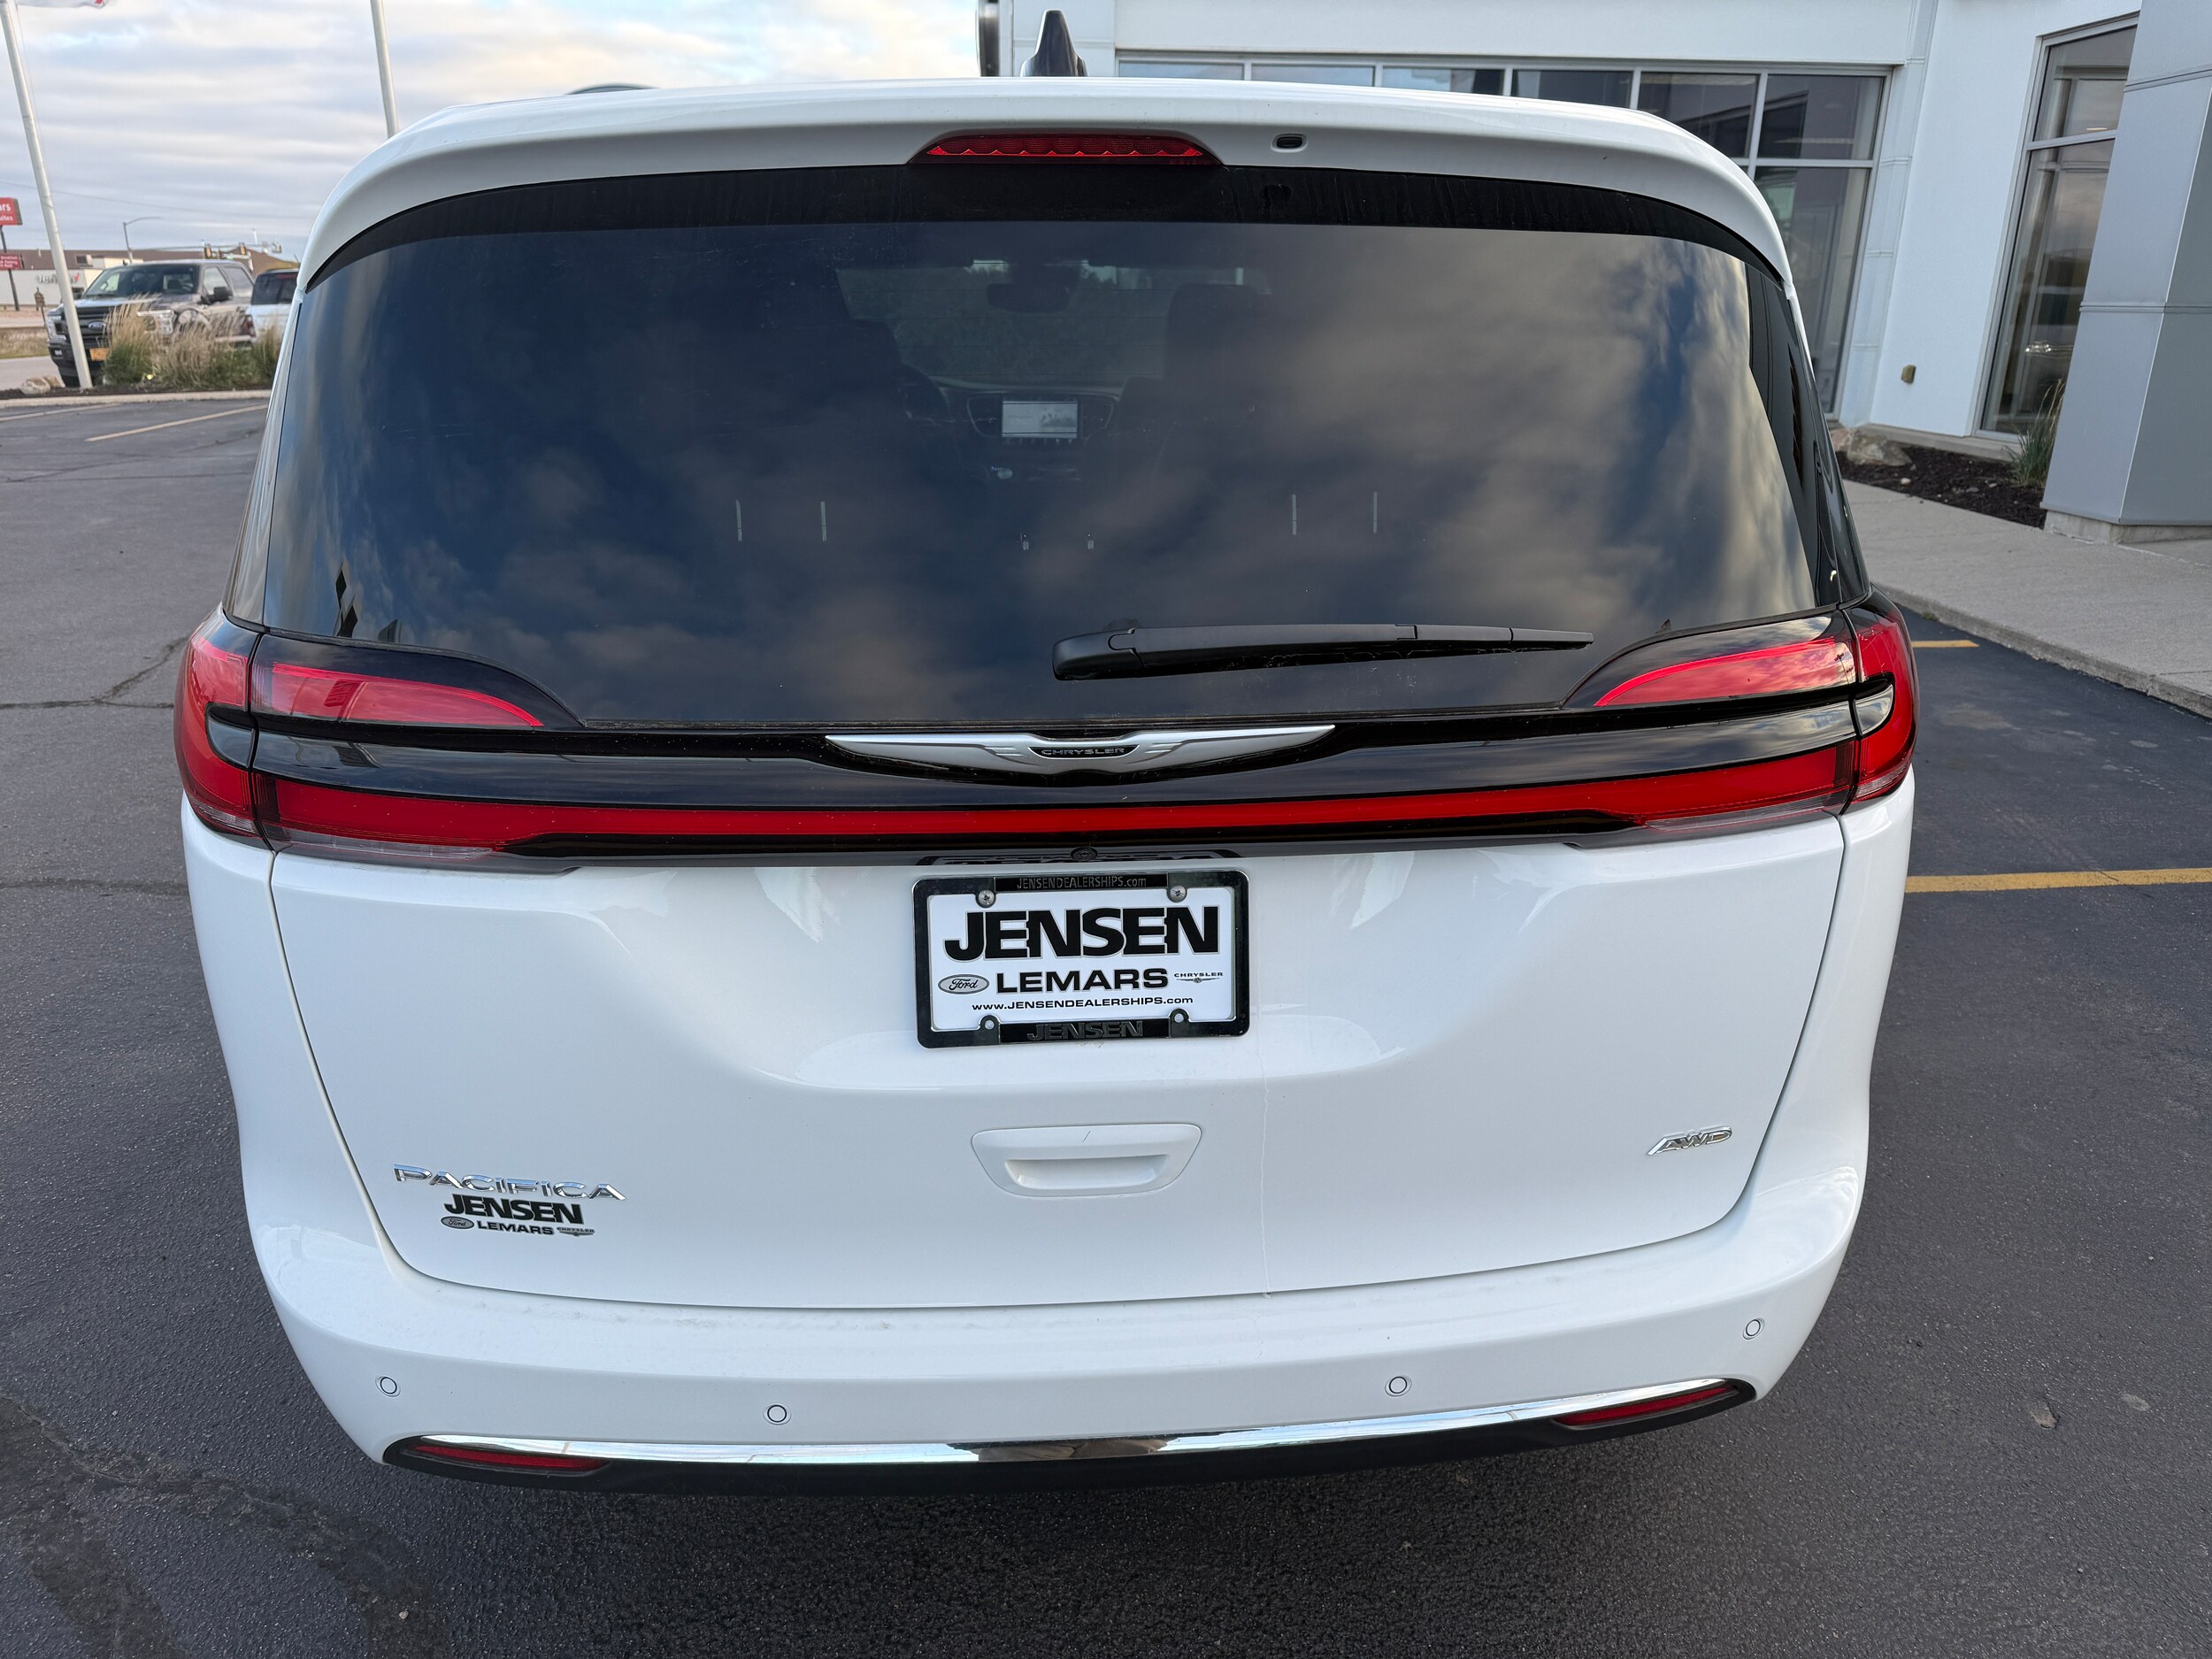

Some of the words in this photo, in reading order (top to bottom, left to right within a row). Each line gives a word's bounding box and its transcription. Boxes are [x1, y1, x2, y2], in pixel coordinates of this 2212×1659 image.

[1017, 875, 1147, 890] JENSENDEALERSHIPS.com
[944, 906, 1220, 962] JENSEN
[996, 968, 1169, 995] LEMARS
[972, 996, 1194, 1010] www.JENSENDEALERSHIPS.com
[1026, 1019, 1143, 1041] JENSEN
[1647, 1125, 1732, 1156] AWD
[393, 1164, 627, 1201] PACIFICA
[443, 1194, 584, 1225] JENSEN
[477, 1220, 555, 1236] LEMARS
